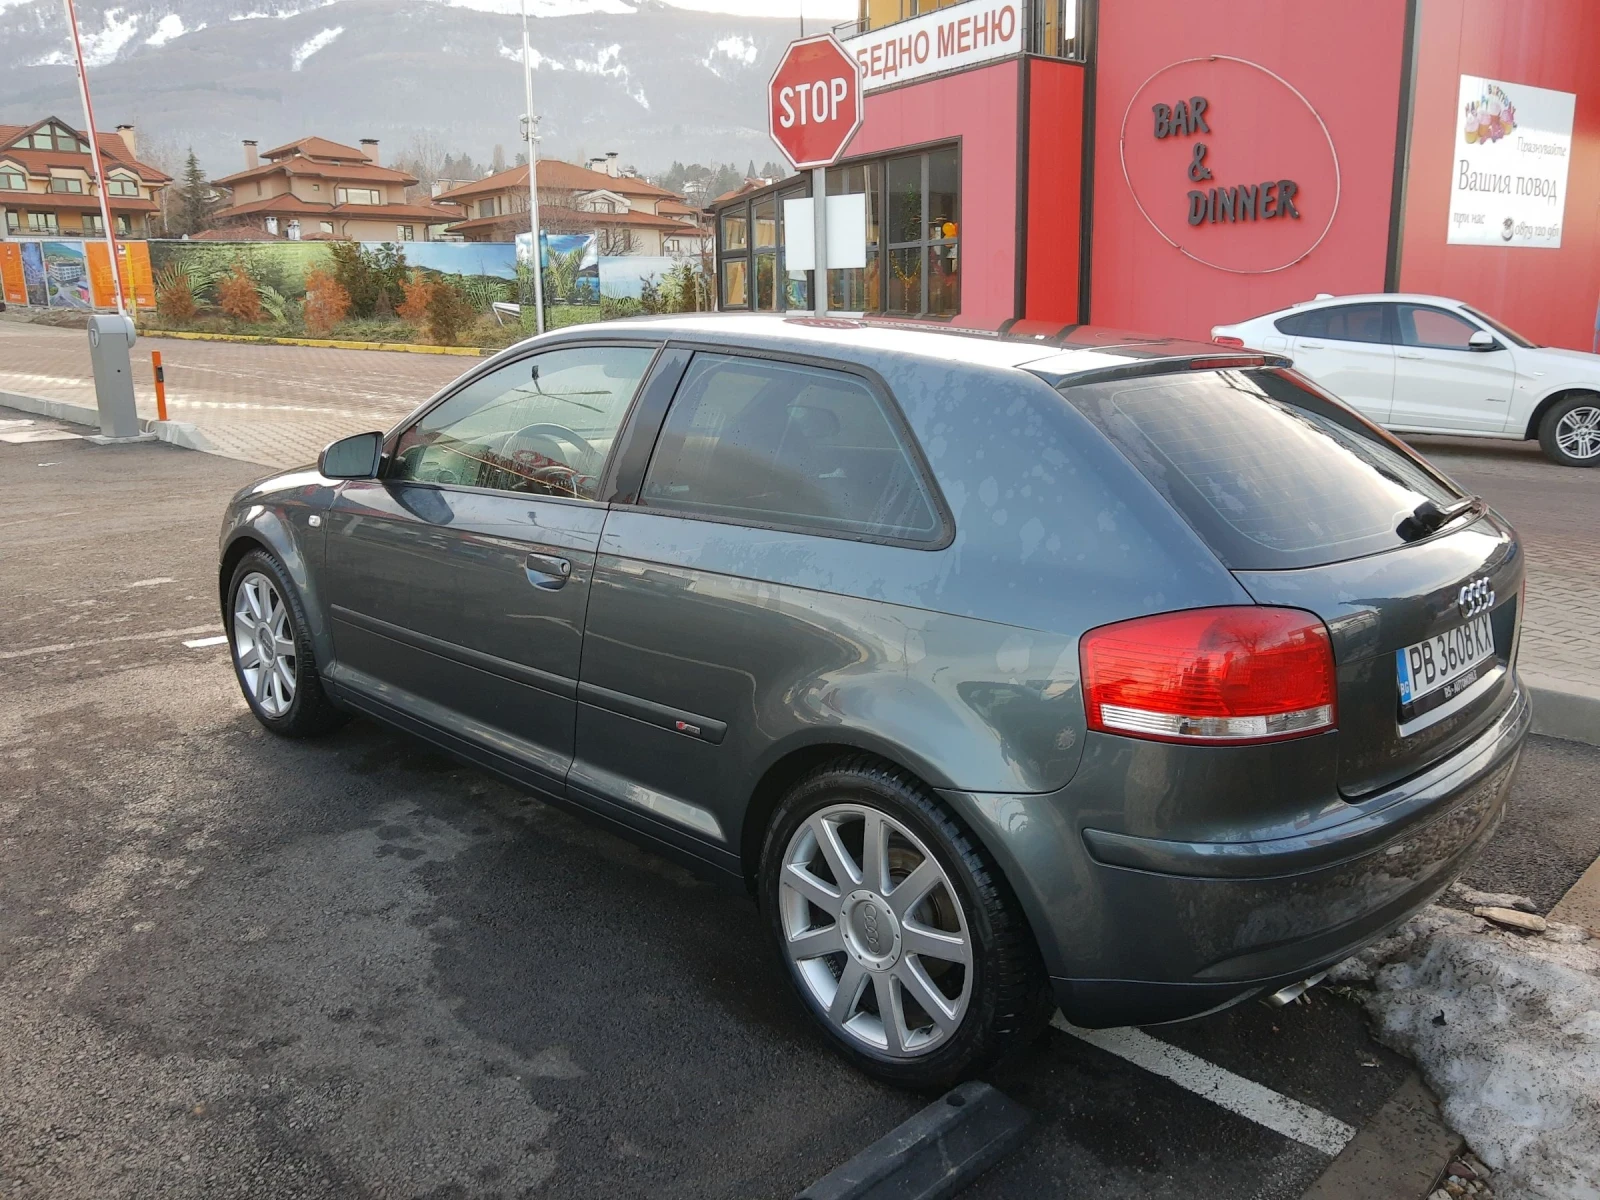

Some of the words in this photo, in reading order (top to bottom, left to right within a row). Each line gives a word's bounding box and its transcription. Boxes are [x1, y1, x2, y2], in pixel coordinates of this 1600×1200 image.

[856, 30, 930, 80] БЕДНО
[937, 5, 1016, 59] МЕНЮ
[779, 77, 848, 128] STOP
[1152, 96, 1210, 139] BAR
[1187, 142, 1212, 182] &
[1458, 159, 1512, 195] Вашия
[1515, 176, 1557, 206] повод
[1187, 179, 1299, 226] DINNER
[1453, 212, 1470, 228] при
[1471, 214, 1486, 225] нас
[1436, 624, 1474, 677] 3608
[1400, 681, 1410, 696] BG
